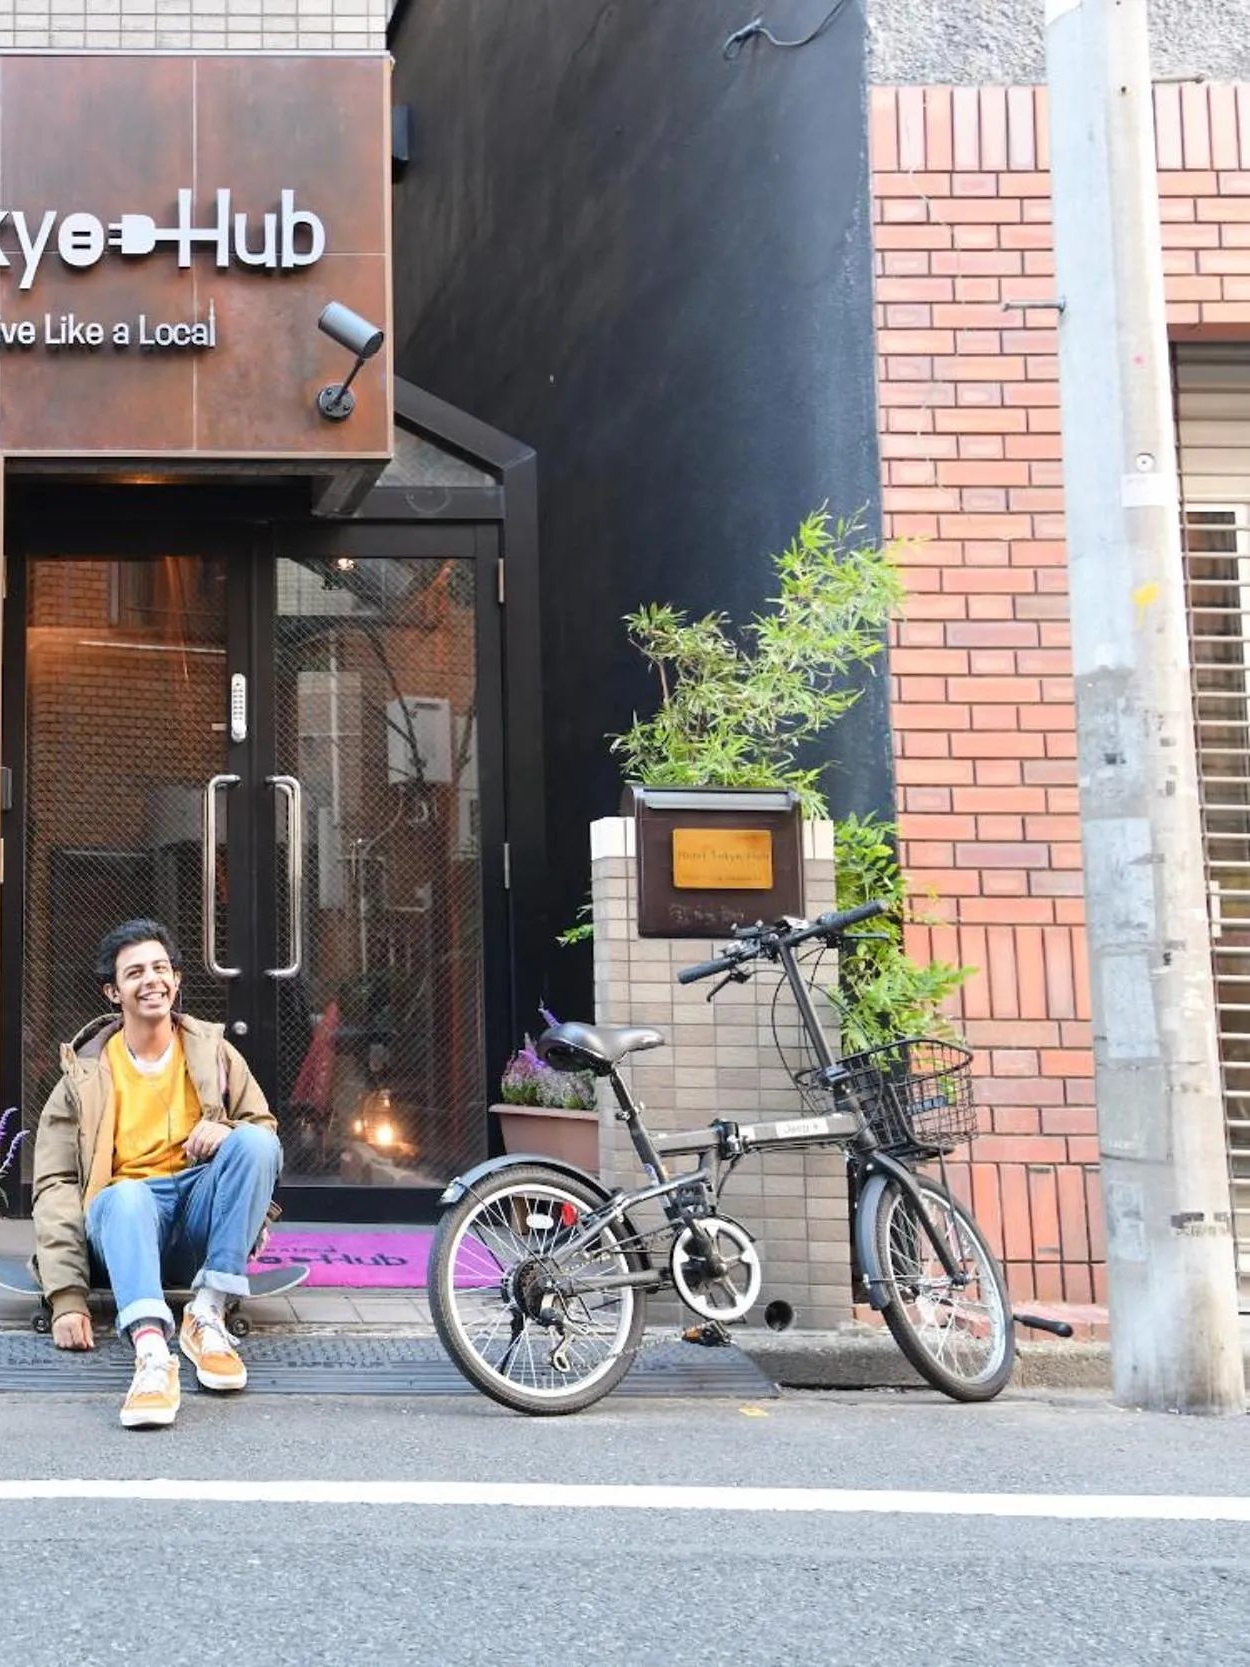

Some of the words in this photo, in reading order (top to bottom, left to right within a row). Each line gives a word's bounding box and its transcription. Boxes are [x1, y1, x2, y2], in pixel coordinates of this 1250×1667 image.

[177, 187, 327, 269] Hub
[44, 312, 105, 346] Like
[112, 319, 130, 346] a
[139, 300, 217, 347] Local
